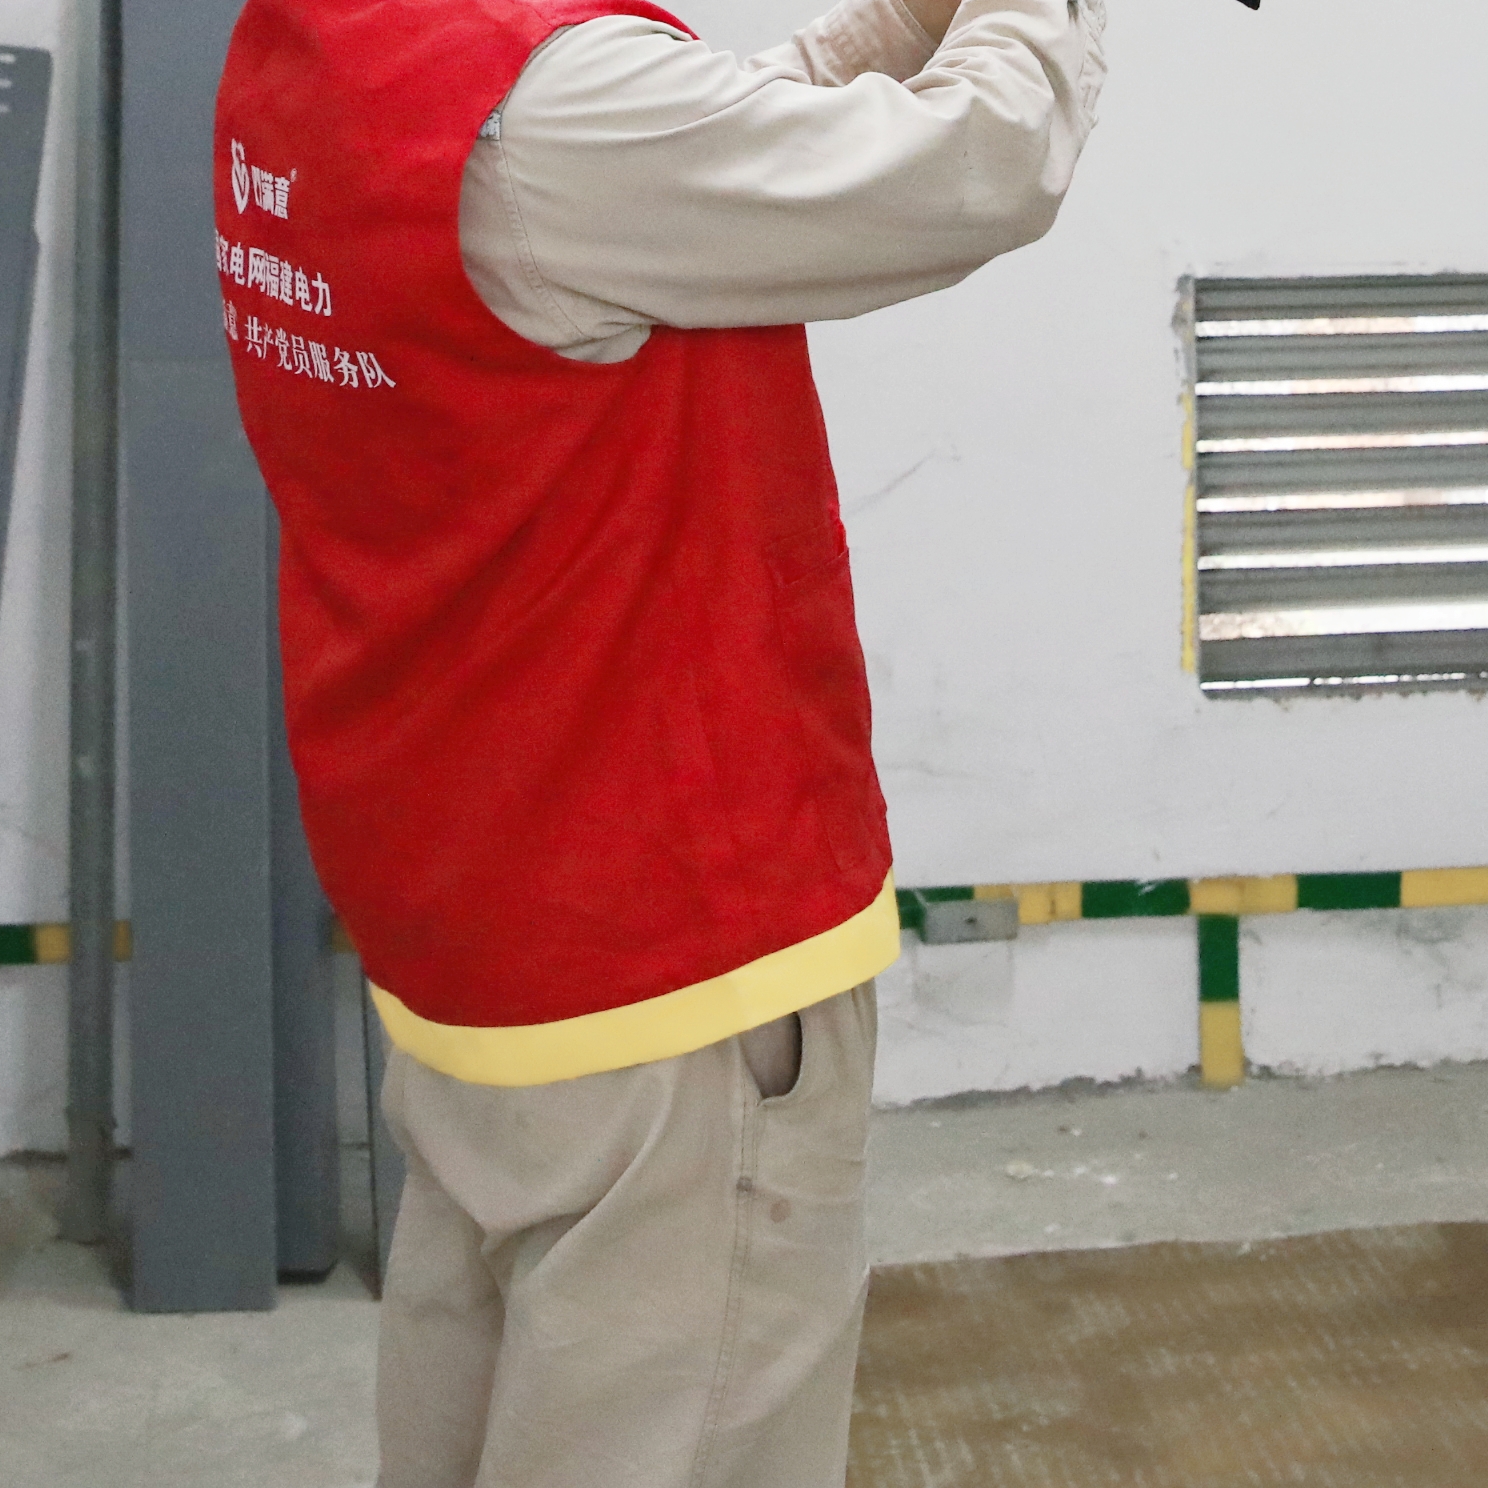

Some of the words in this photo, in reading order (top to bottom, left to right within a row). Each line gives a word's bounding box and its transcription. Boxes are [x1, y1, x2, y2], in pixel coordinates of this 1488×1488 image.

[244, 315, 396, 389] 共产党员服务队
